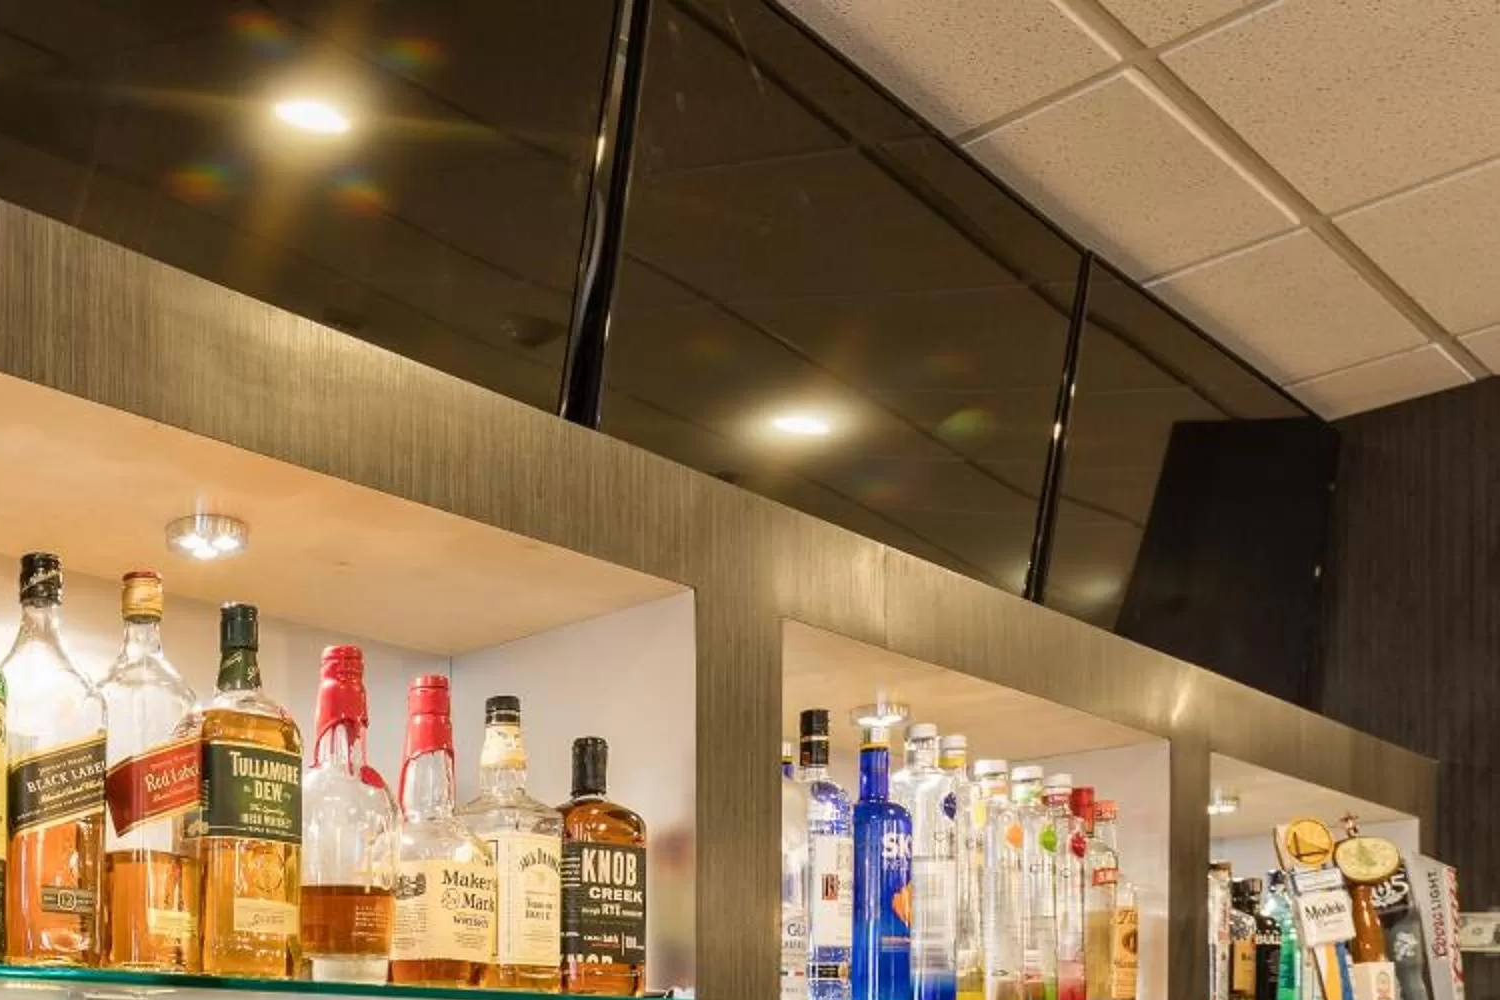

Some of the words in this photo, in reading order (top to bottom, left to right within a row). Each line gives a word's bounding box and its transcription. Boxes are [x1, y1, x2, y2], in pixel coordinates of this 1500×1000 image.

[228, 751, 299, 785] TULLAMORE
[27, 771, 69, 793] BLACK
[882, 832, 913, 858] SK
[581, 847, 638, 888] KNOB
[588, 886, 644, 904] CREEK
